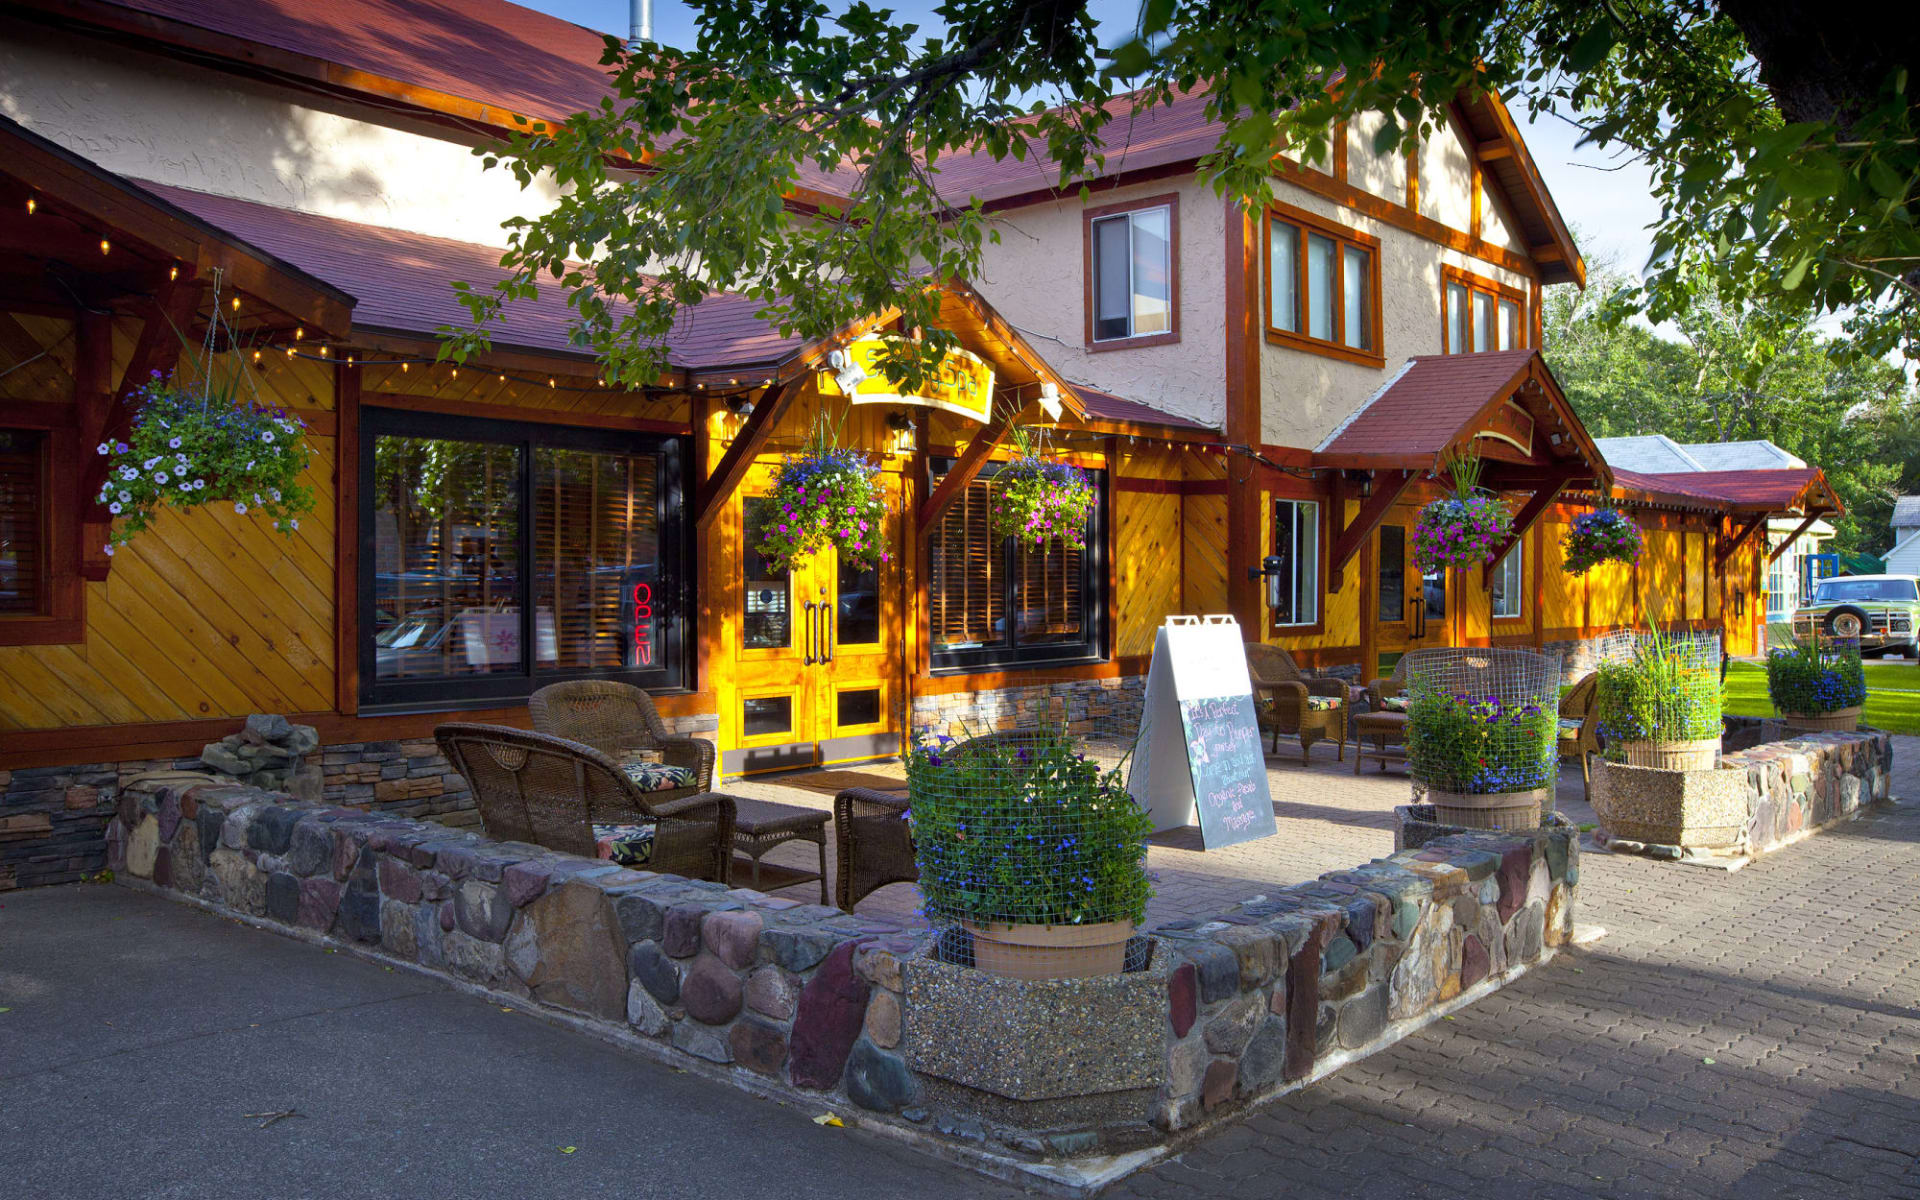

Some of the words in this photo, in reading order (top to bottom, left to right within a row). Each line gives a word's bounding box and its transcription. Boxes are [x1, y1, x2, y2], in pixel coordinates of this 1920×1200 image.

[944, 358, 977, 398] Spa
[634, 583, 652, 665] OPEN
[1209, 701, 1240, 719] Perfect
[1215, 720, 1226, 737] to
[1208, 787, 1236, 808] Organic
